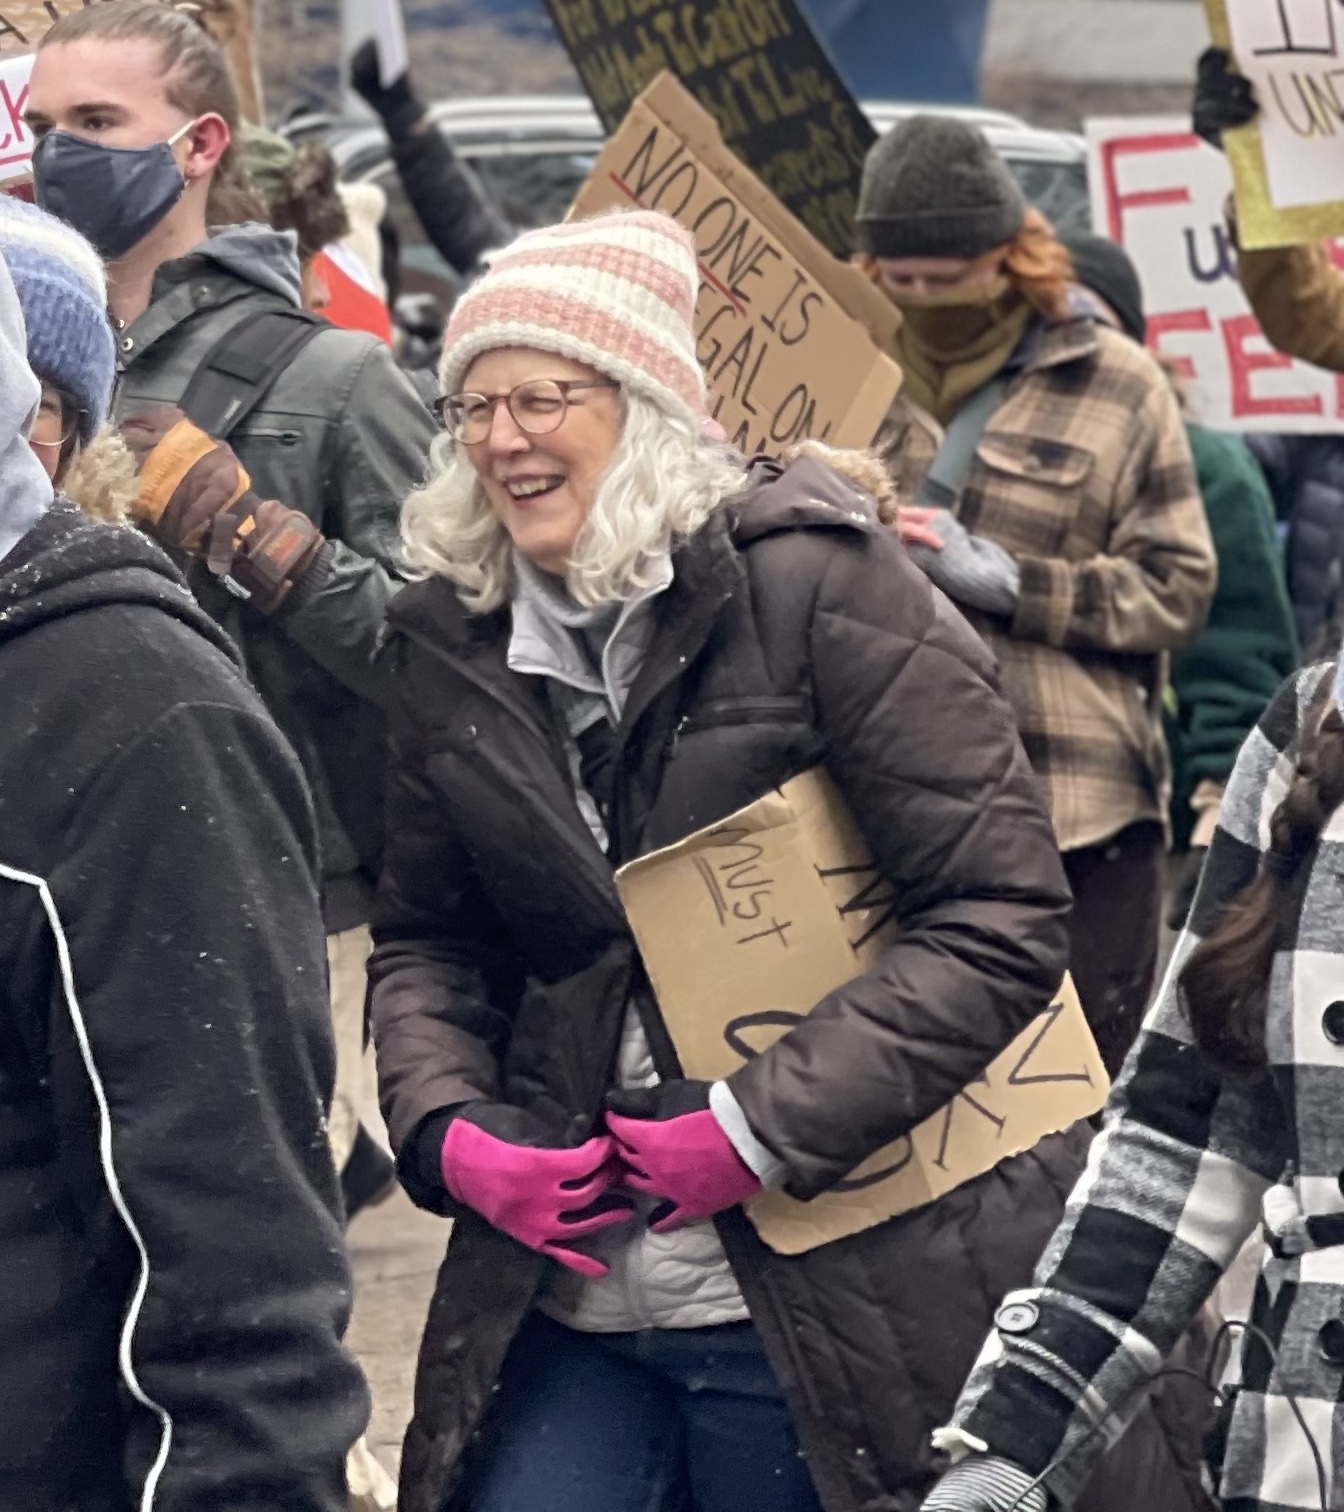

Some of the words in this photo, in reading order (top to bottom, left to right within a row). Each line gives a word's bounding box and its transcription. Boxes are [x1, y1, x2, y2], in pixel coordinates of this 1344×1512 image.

[621, 125, 699, 219] NO
[693, 197, 783, 305] ONE
[761, 267, 824, 346] IS
[770, 383, 832, 444] ON
